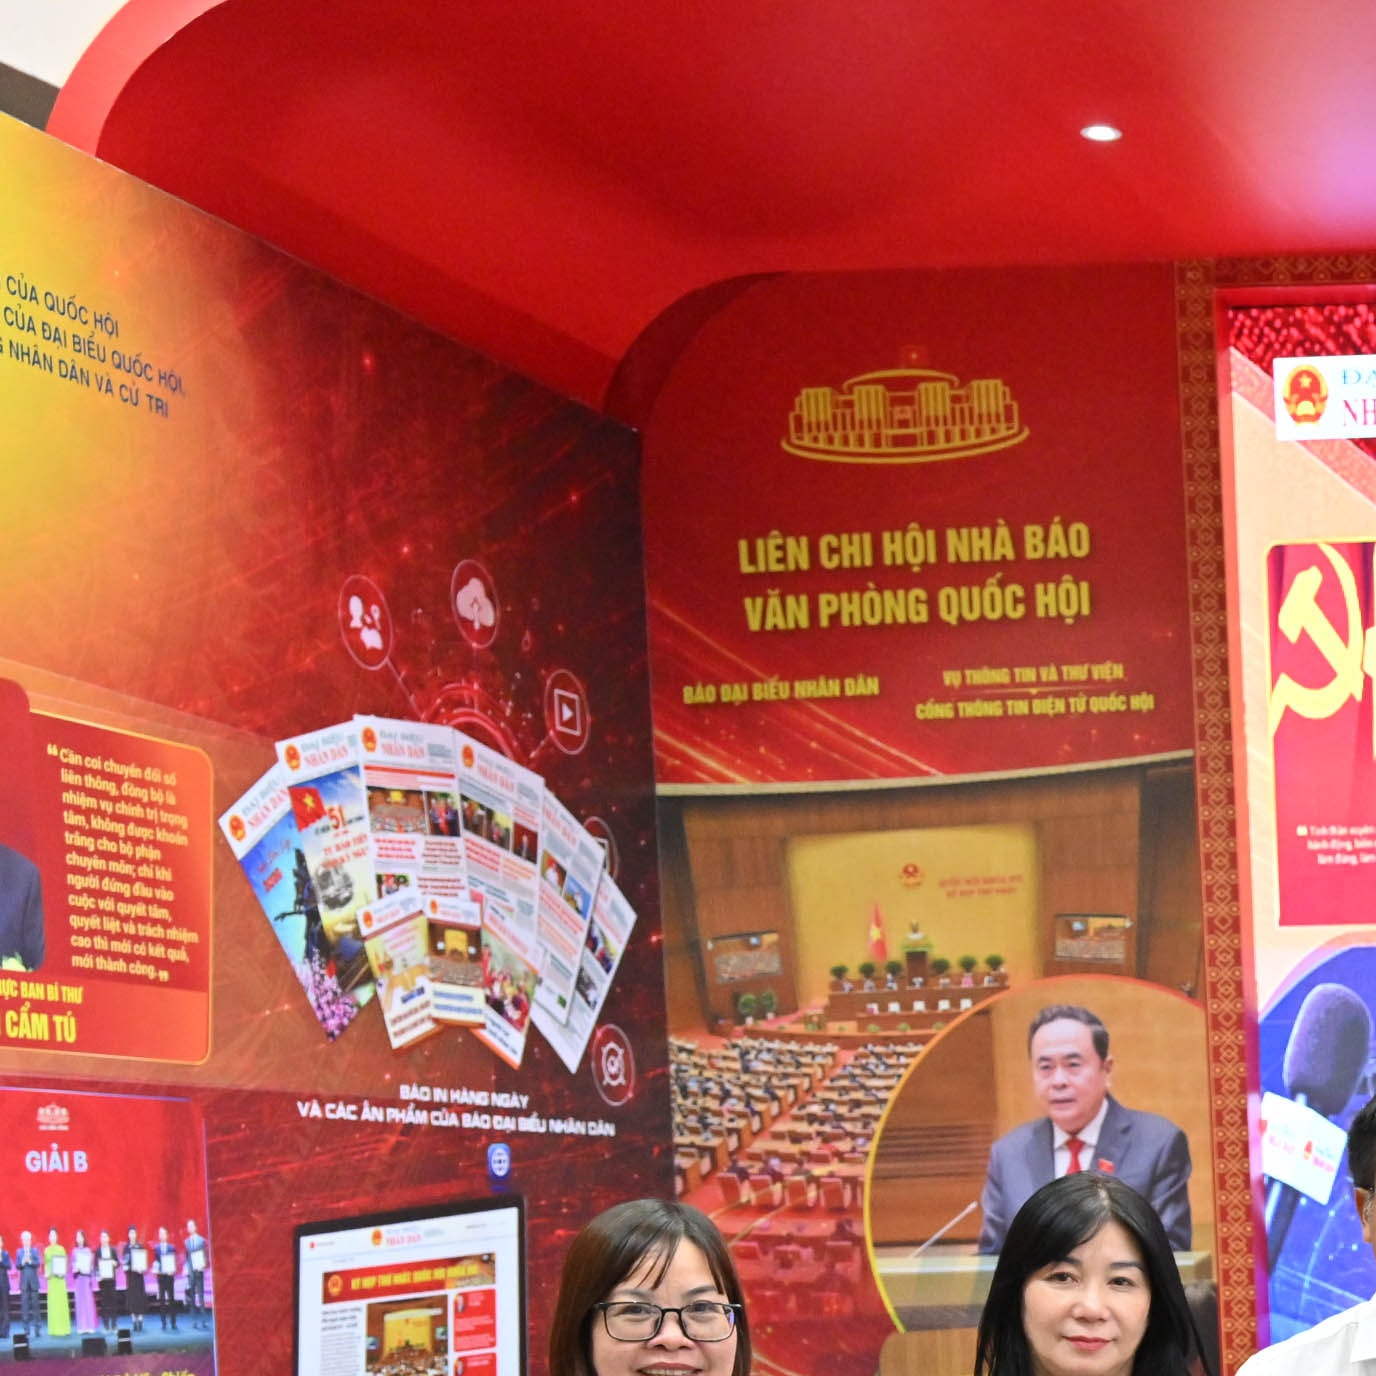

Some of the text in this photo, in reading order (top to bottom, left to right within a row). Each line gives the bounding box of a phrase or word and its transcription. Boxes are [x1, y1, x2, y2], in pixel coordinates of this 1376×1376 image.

[6, 272, 119, 340] CỦA QUỐC HỘI
[3, 303, 37, 337] CỦA
[41, 320, 68, 350] ĐẠI
[72, 330, 107, 364] BIỂU
[111, 351, 154, 382] QUỐC
[9, 339, 54, 374] NHÂN
[58, 358, 91, 388] DÂN
[95, 372, 114, 398] VÀ
[145, 393, 169, 418] TRI
[738, 515, 1091, 574] LIÊN CHI HỘI NHÀ BÁO
[744, 572, 1091, 631] VĂN PHÒNG QUỐC HỘI
[683, 674, 879, 707] BÁO ĐẠI BIỂU NHÂN DÂN
[943, 670, 963, 689] VỤ
[964, 663, 1012, 686] THÔNG
[1014, 666, 1036, 683] TIN
[1039, 662, 1060, 683] VÀ
[1092, 660, 1125, 682] VIỆN
[915, 696, 954, 721] CỔNG
[957, 695, 1005, 719] THÔNG
[1007, 698, 1029, 716] TIN
[1031, 692, 1067, 718] ĐIỆN
[1089, 690, 1128, 713] QUỐC
[1129, 689, 1155, 711] HỘI
[20, 981, 46, 1001] BAN
[5, 1001, 77, 1043] CẨM TÚ
[399, 1082, 432, 1102] BÁO
[433, 1086, 448, 1103] IN
[296, 1099, 324, 1119] VÀ
[324, 1102, 359, 1121] CÁC
[386, 1102, 429, 1125] PHẨM
[430, 1107, 460, 1127] CỦA
[548, 1118, 586, 1136] NHÂN
[24, 1142, 89, 1173] GIẢI B
